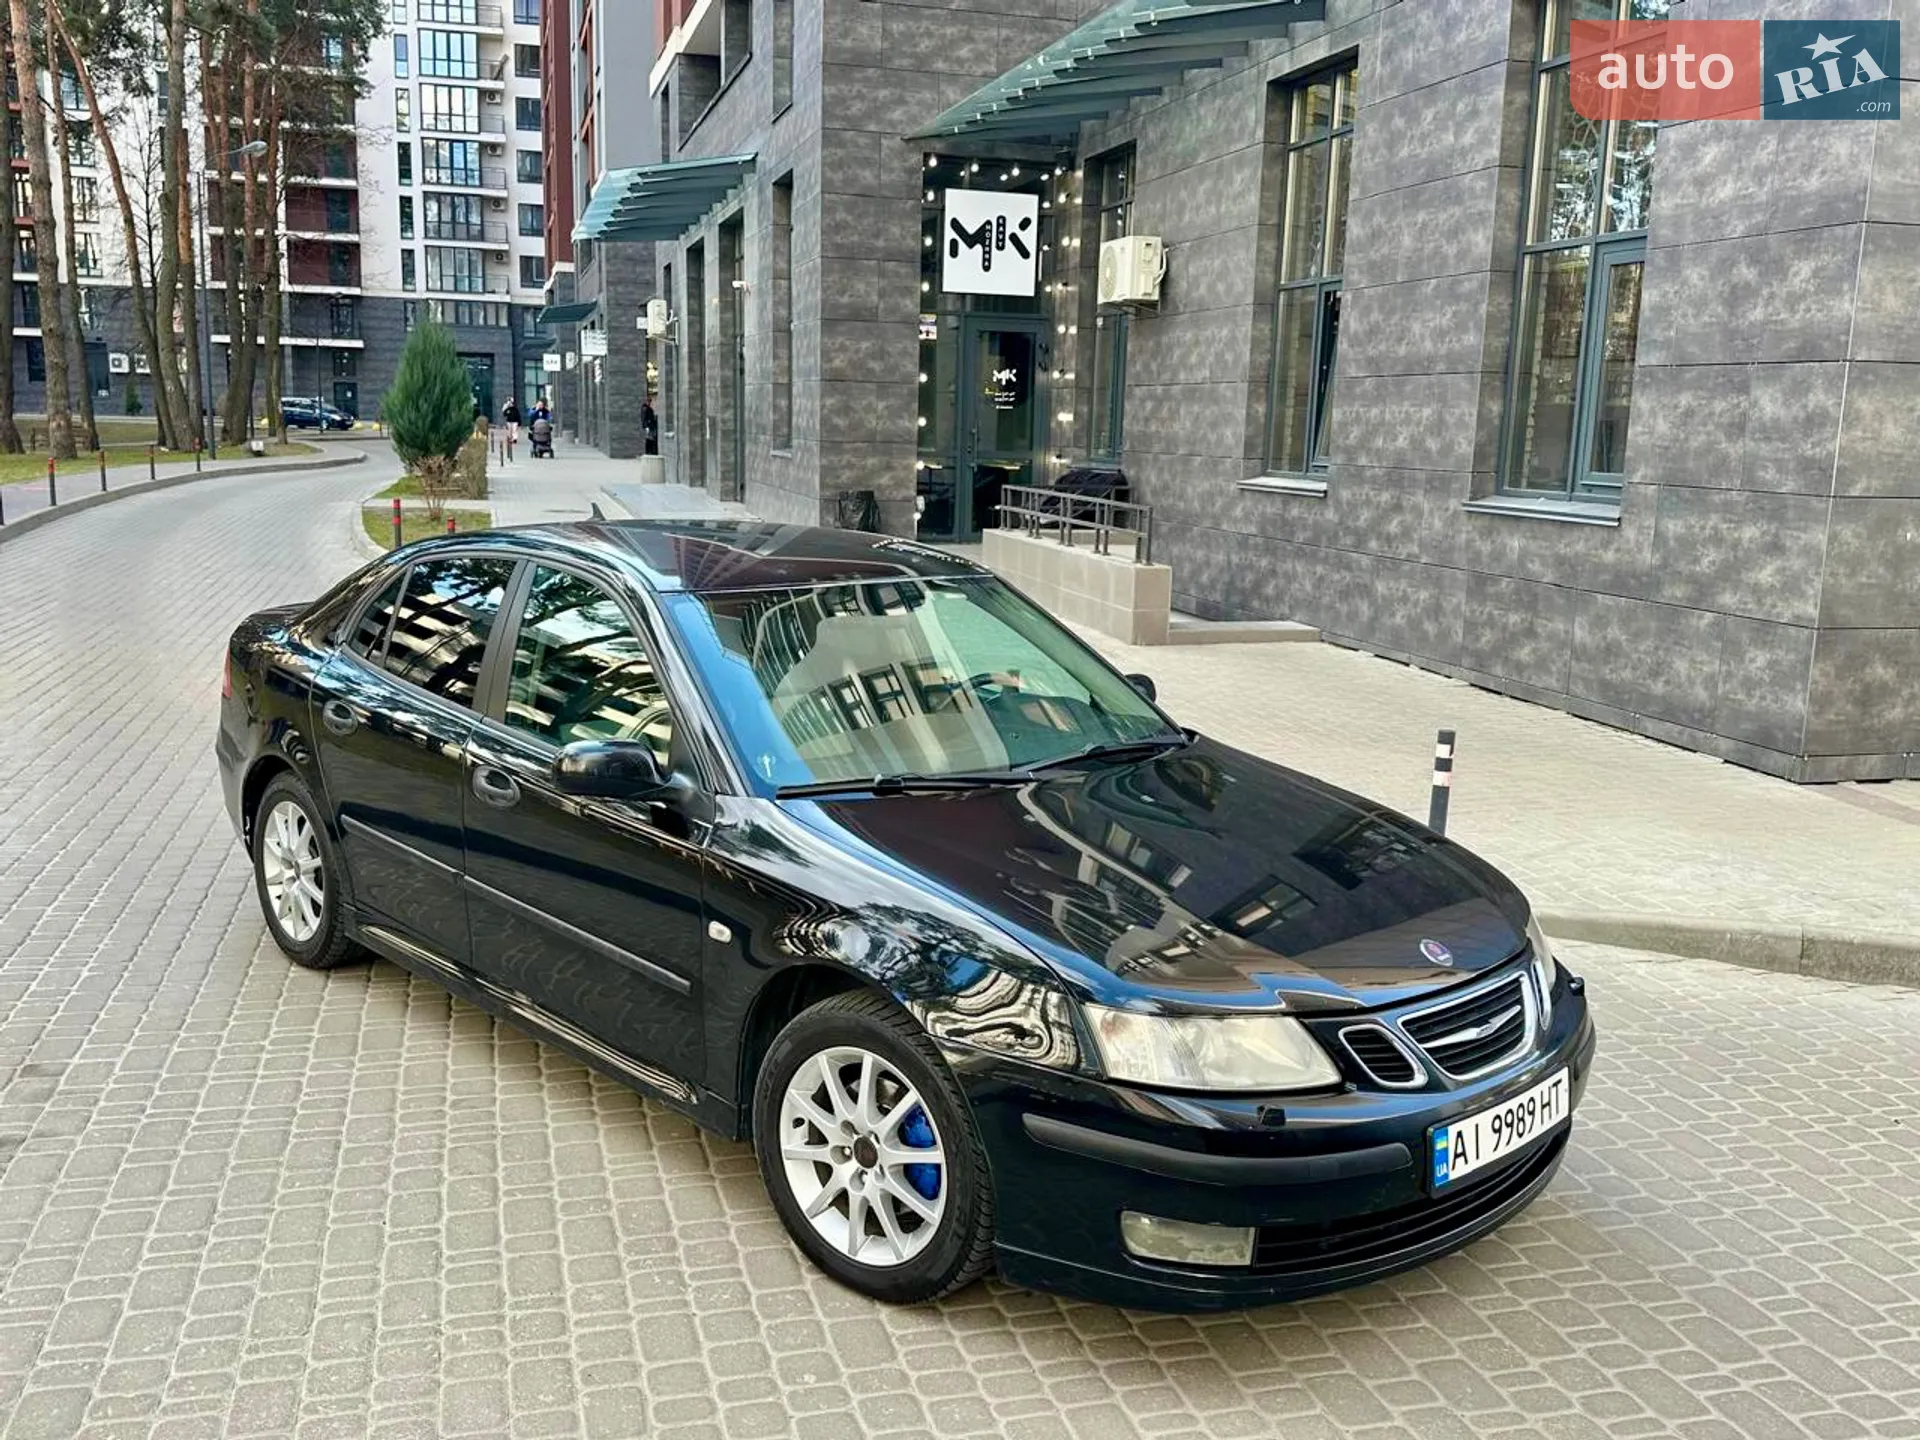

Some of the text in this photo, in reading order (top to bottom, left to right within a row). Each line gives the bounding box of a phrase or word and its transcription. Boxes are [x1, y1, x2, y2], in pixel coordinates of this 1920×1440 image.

[1451, 1077, 1563, 1171] AI 9989 HT
[1436, 1162, 1448, 1177] UA
